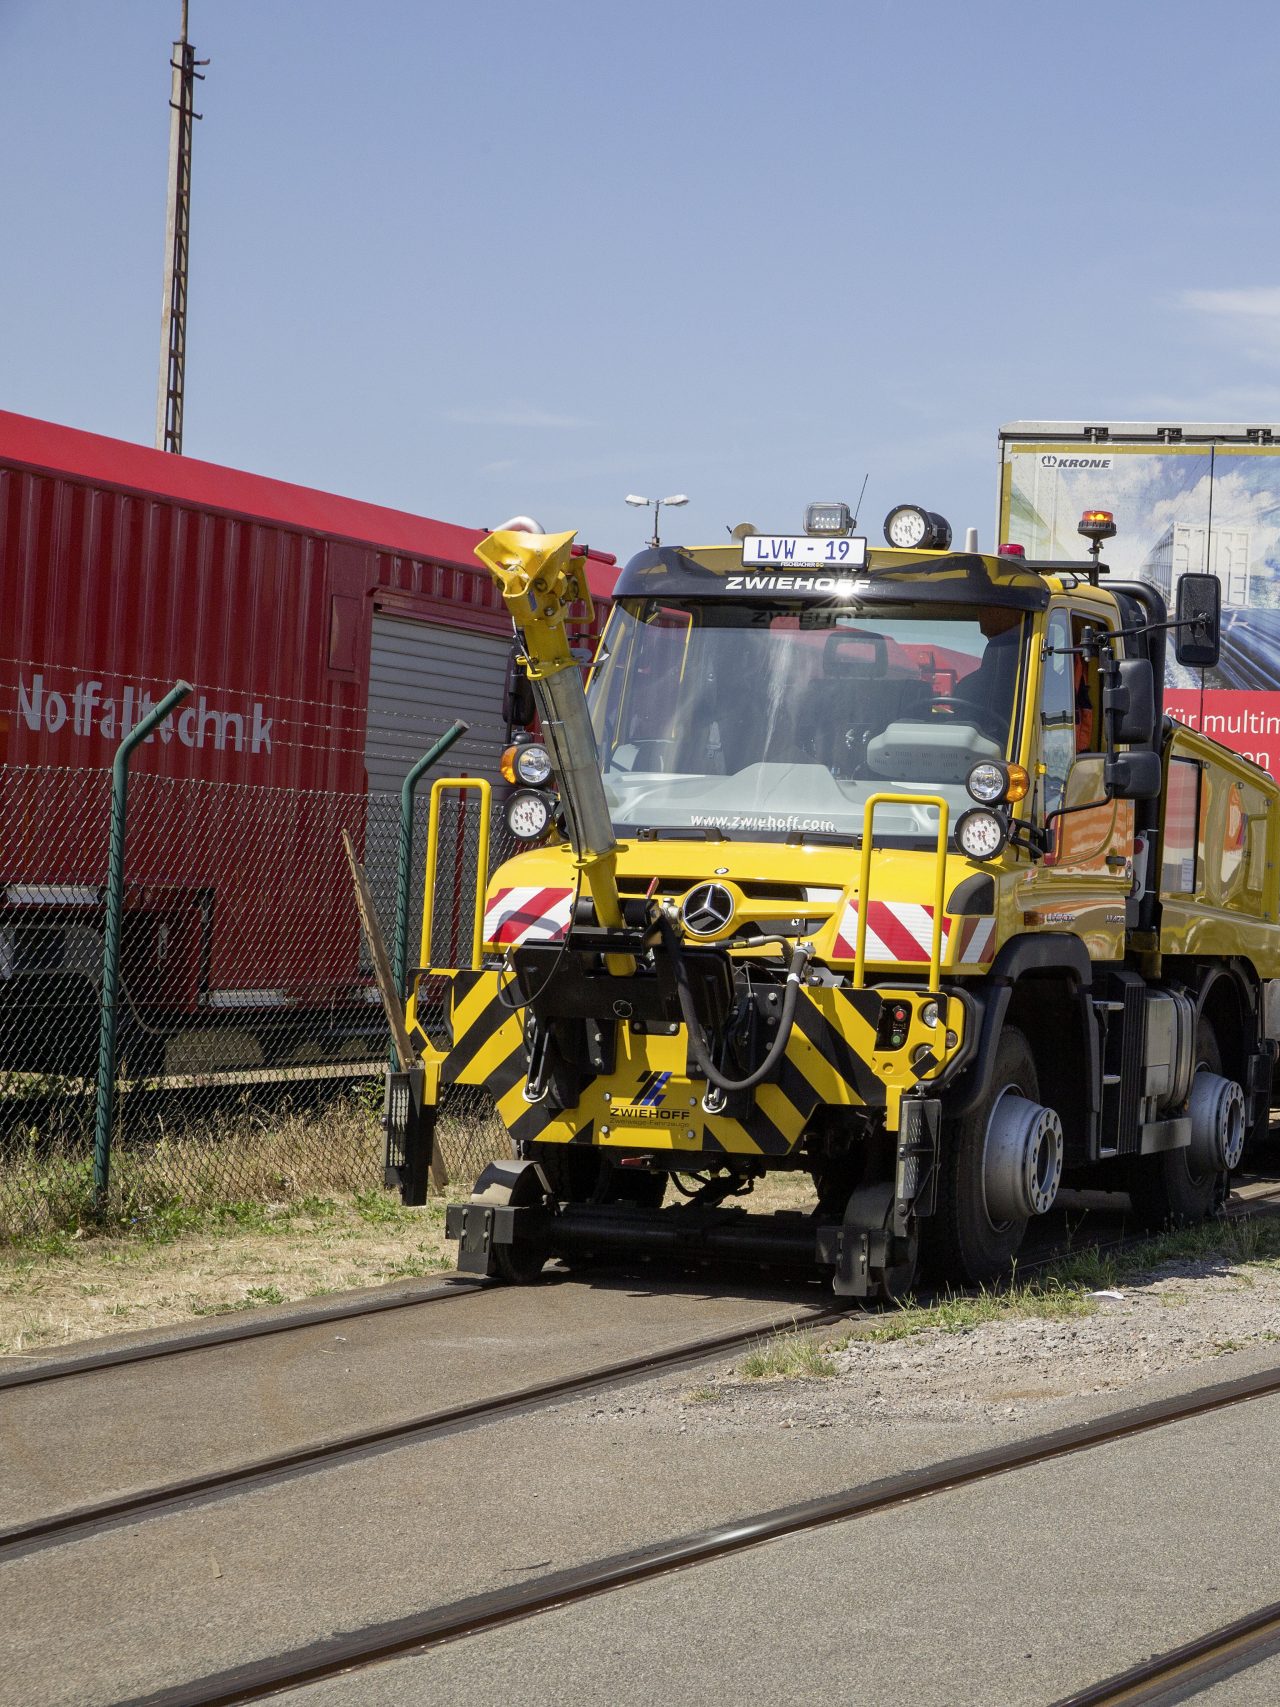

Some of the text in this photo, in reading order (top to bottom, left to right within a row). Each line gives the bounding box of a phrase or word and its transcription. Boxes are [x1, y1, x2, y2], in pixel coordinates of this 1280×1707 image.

[1057, 459, 1111, 468] KRONE
[757, 539, 797, 560] LVW
[824, 540, 850, 561] 19
[690, 815, 835, 831] www.zwiehoff.com
[610, 1108, 690, 1120] ZWIEHOFF
